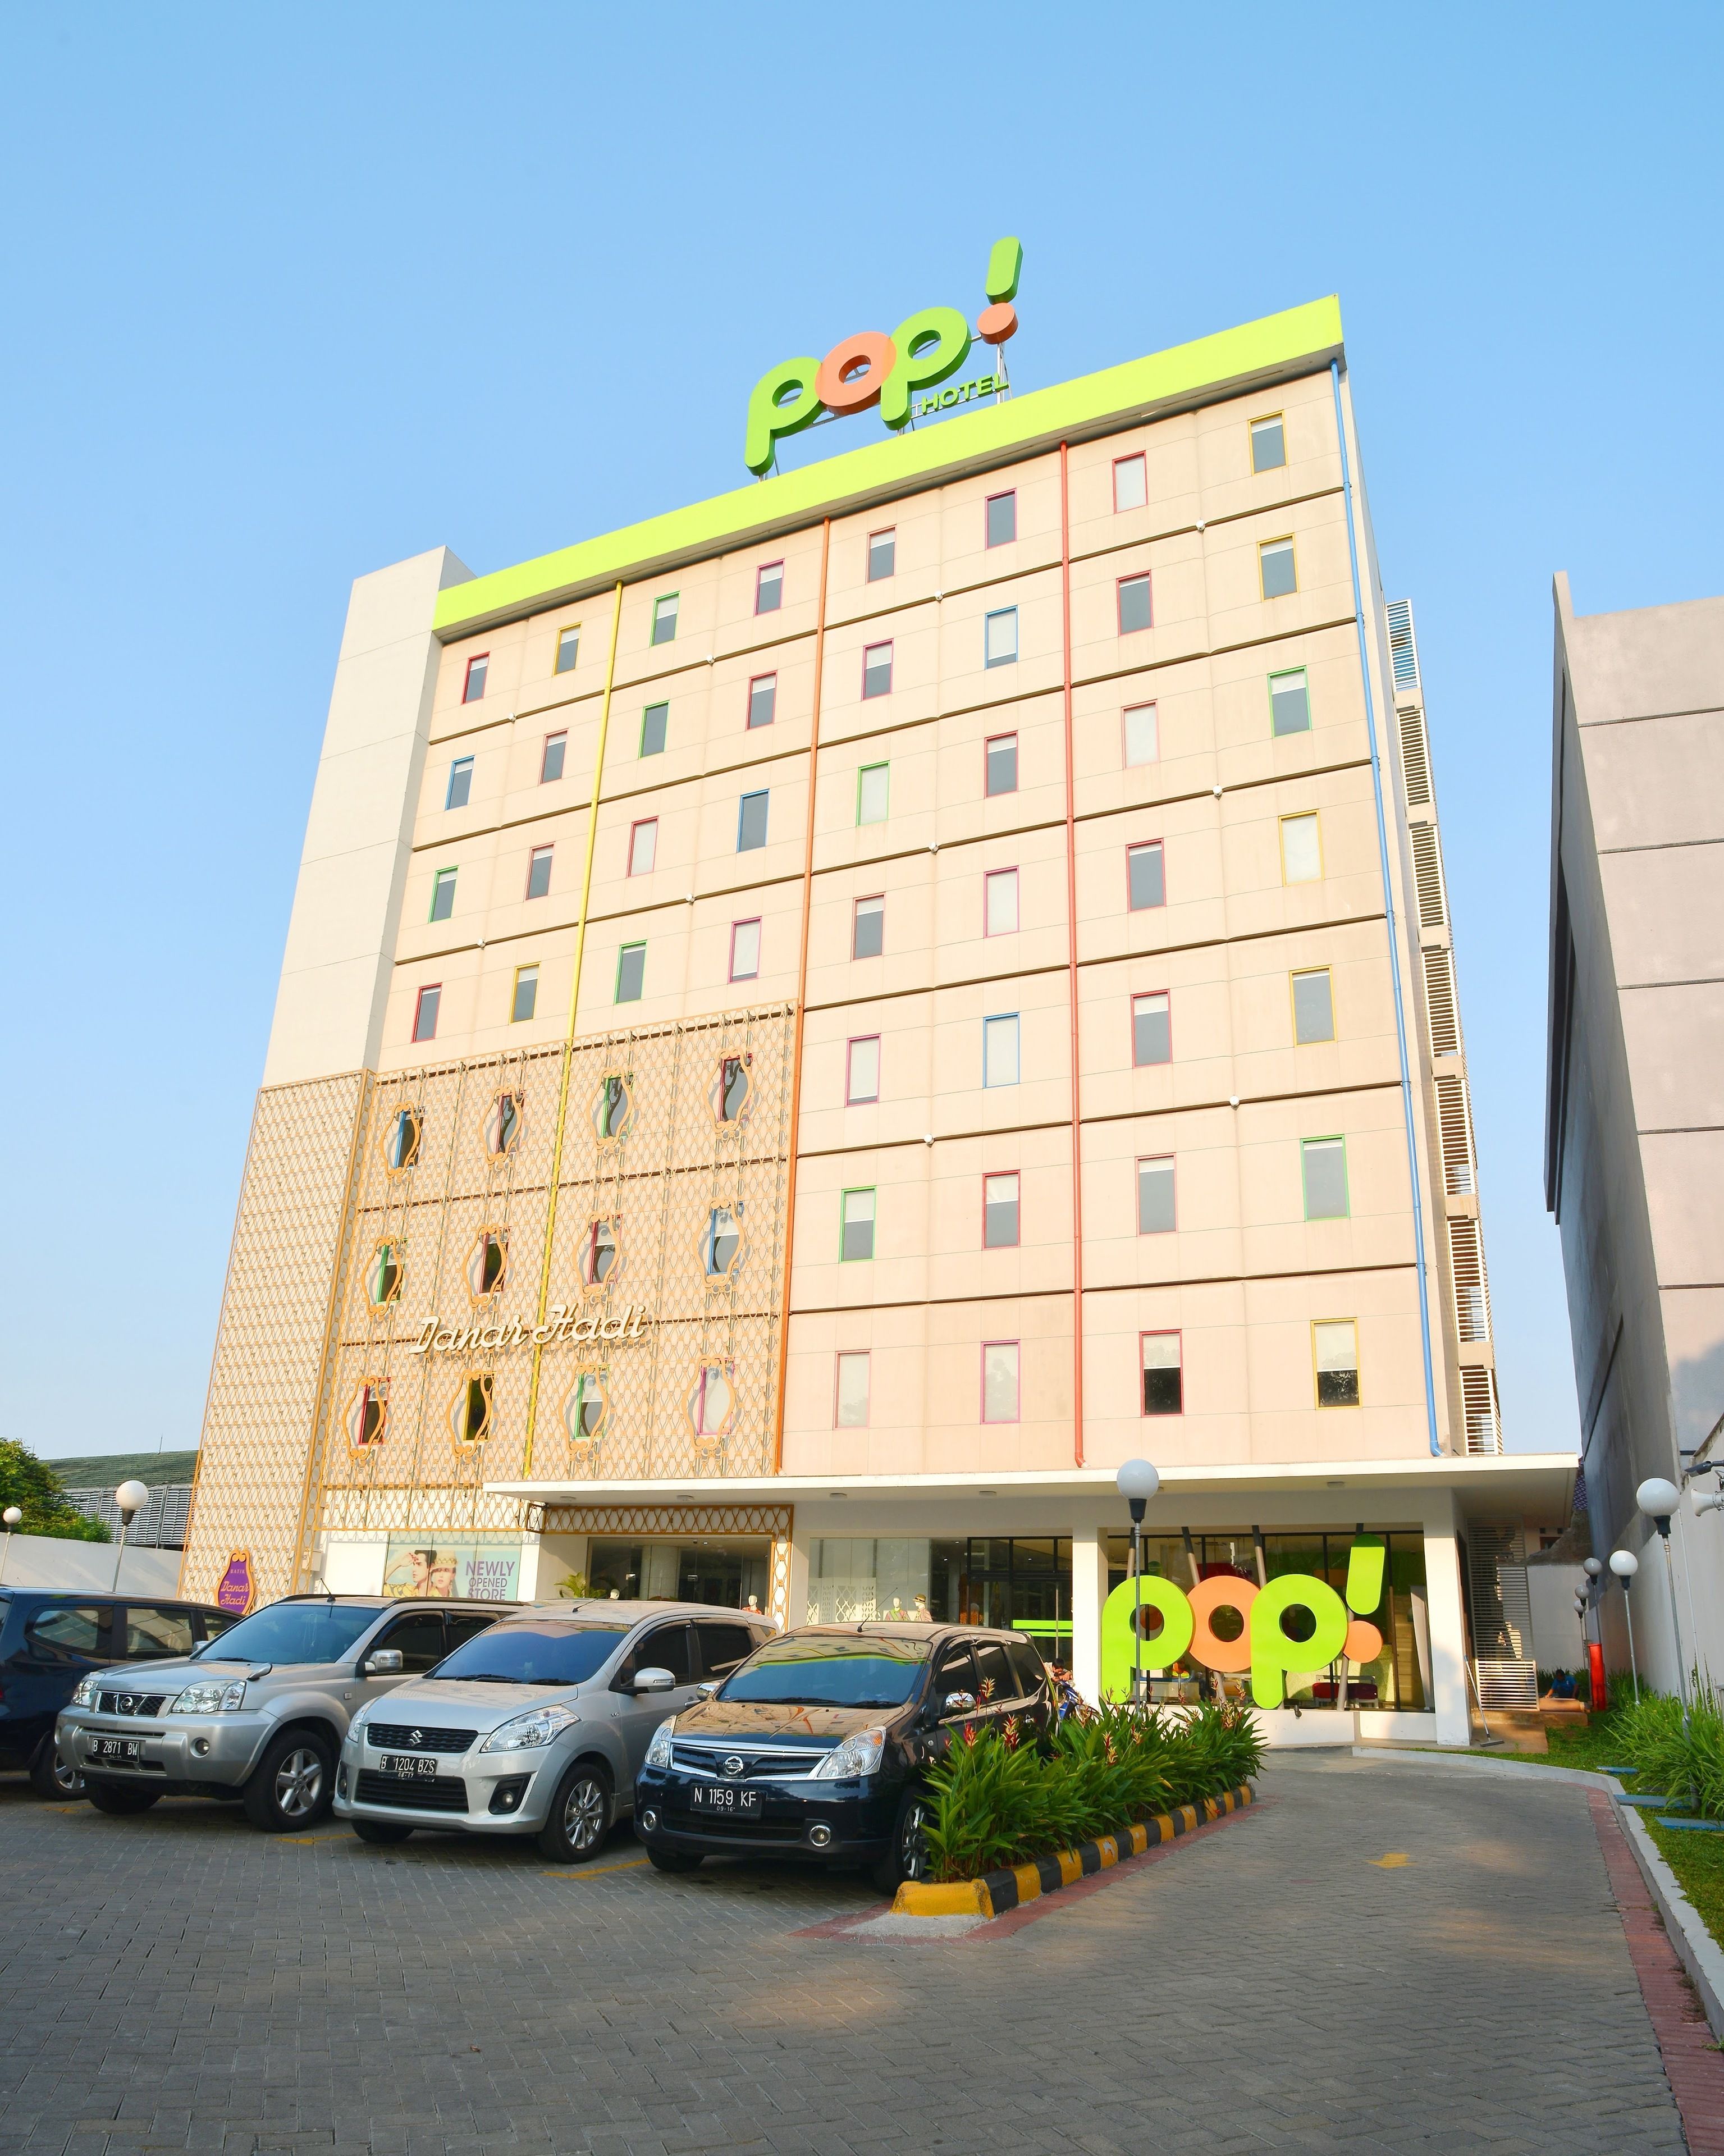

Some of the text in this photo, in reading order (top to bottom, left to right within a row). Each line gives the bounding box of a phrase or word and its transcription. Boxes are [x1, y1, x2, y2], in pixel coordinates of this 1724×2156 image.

[744, 236, 1023, 476] pop!
[921, 372, 1009, 416] HOTEL
[409, 1303, 652, 1354] Danar Hadi
[465, 1561, 515, 1577] NEWLY
[220, 1581, 249, 1592] Danar
[469, 1578, 507, 1588] OPENED
[221, 1593, 246, 1605] Hadi
[468, 1588, 506, 1600] STORE
[1101, 1533, 1385, 1710] pop!
[93, 1739, 138, 1756] B 2871 BW
[381, 1756, 435, 1773] B 1204 BZS
[694, 1787, 756, 1807] N 1159 KF
